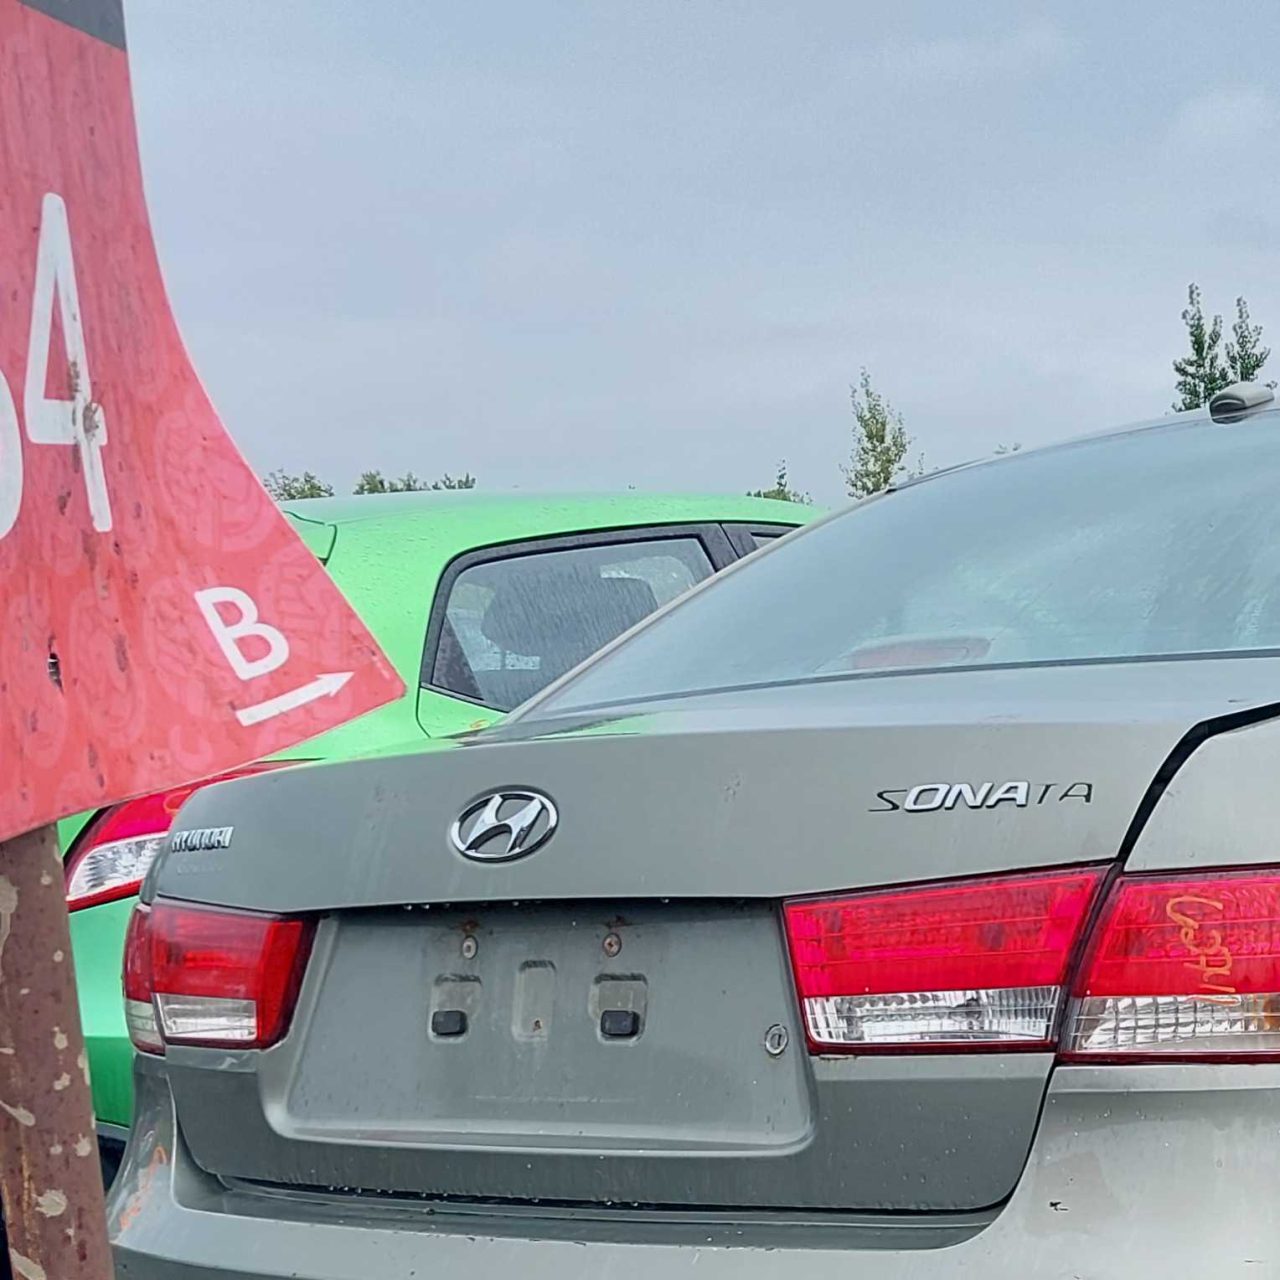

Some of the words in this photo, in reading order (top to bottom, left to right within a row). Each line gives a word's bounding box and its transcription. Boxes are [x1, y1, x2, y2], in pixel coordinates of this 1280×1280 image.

[194, 586, 289, 681] B
[868, 781, 1093, 813] SONATA
[171, 826, 234, 853] HYUNDAI
